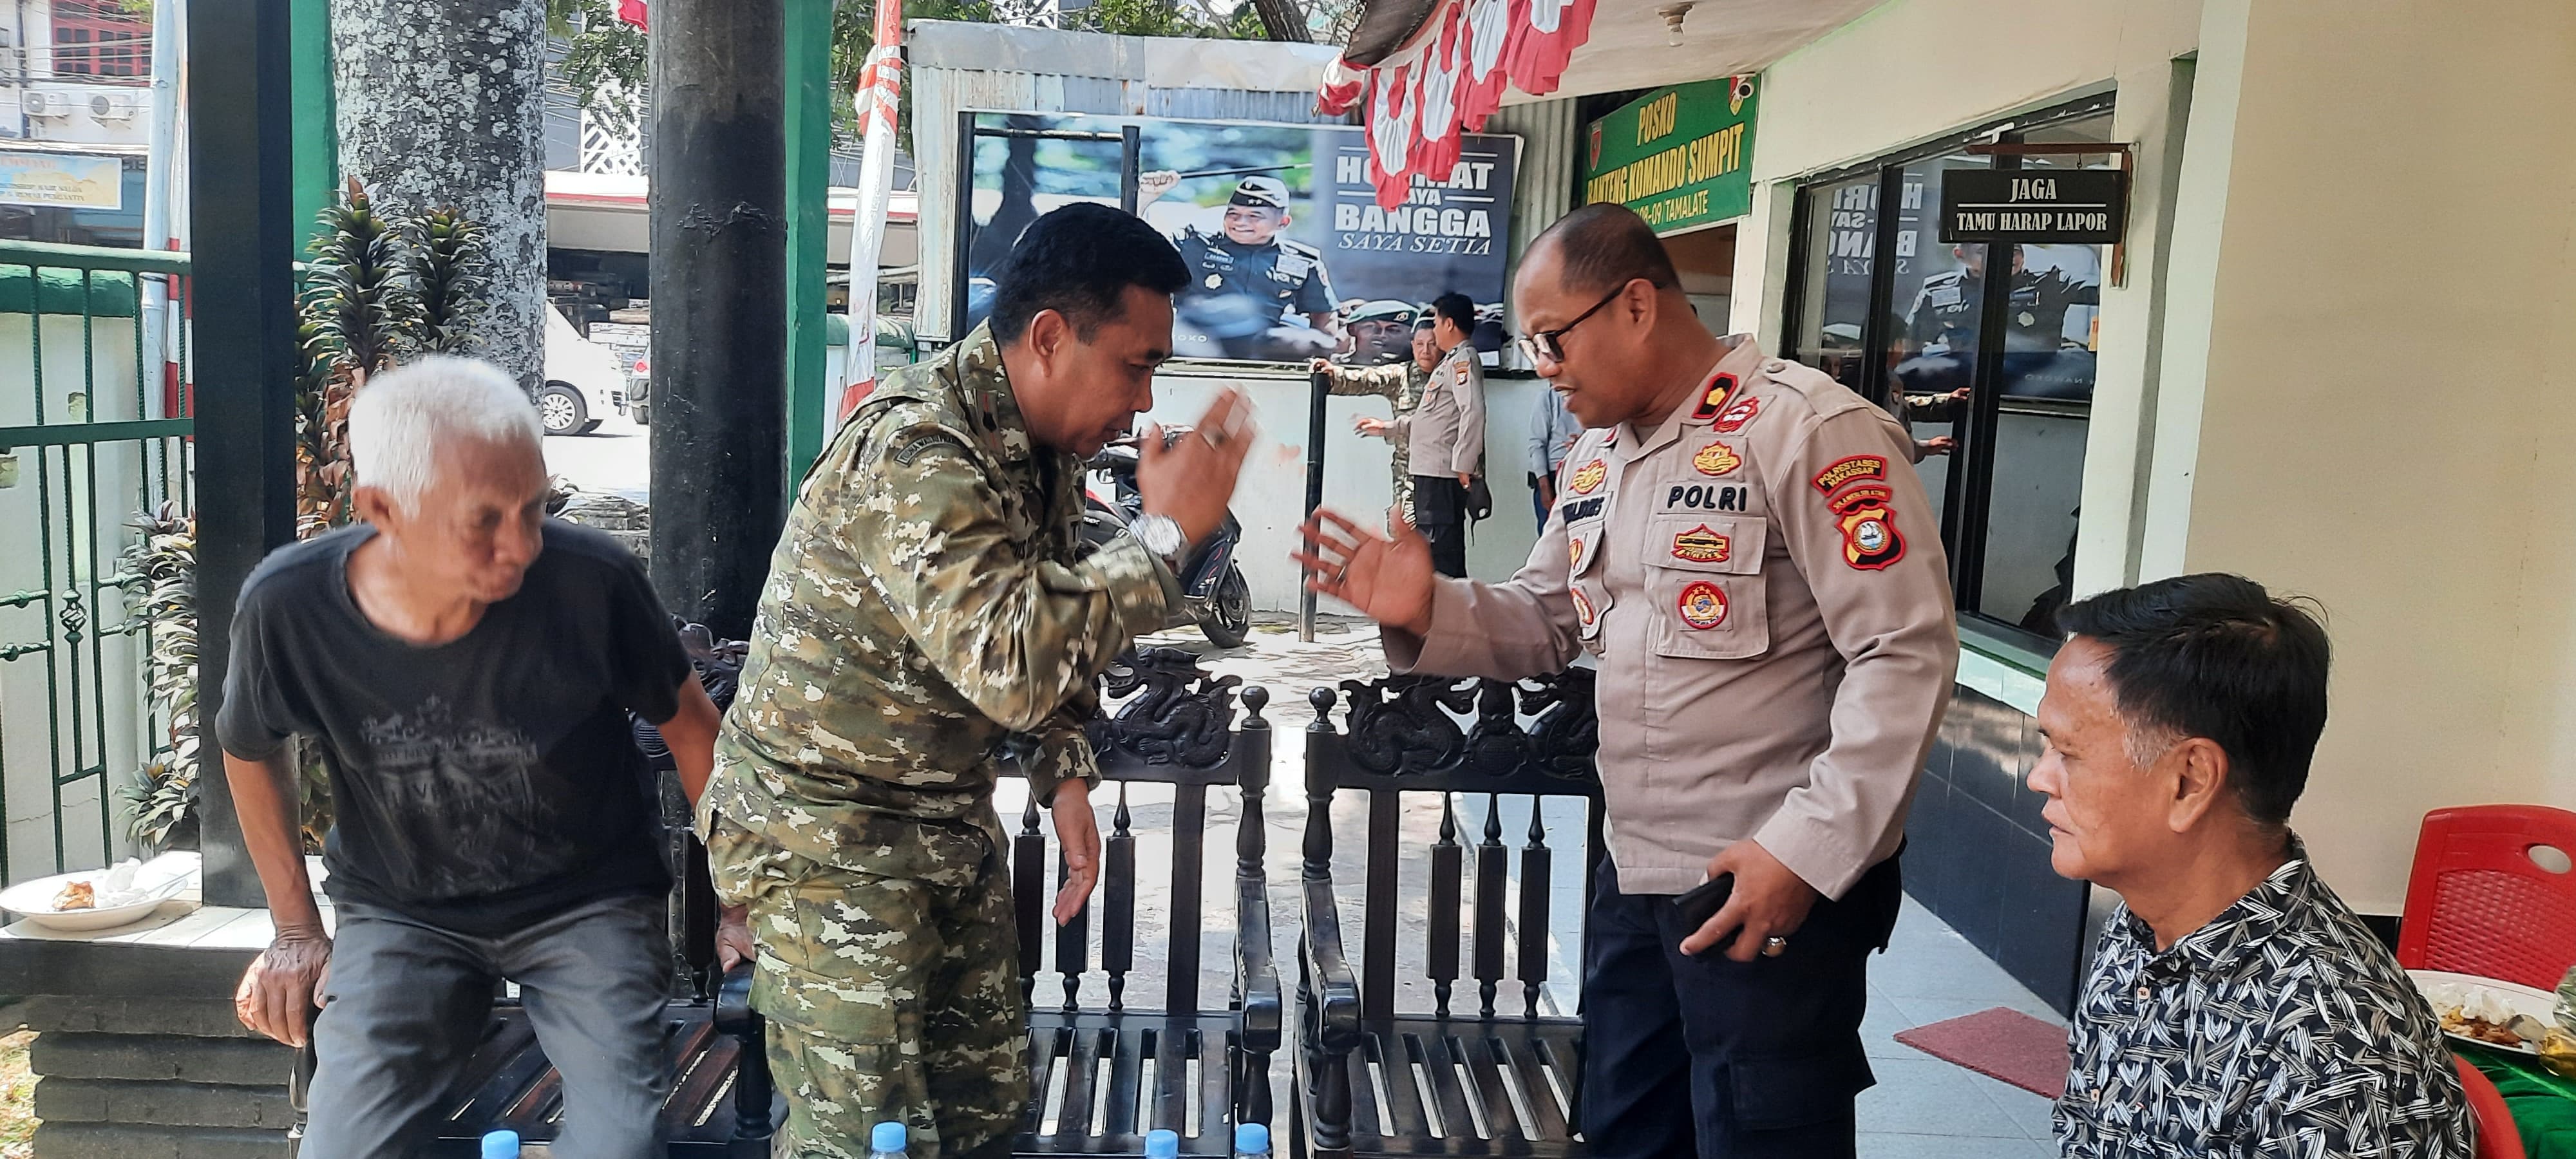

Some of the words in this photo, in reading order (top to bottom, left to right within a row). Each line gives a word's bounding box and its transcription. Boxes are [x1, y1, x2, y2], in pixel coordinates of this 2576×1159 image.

[1637, 92, 1677, 146] POSKO
[1628, 145, 1686, 202] KOMANDO
[1688, 123, 1745, 185] SUMPIT
[1408, 188, 1442, 205] AYA
[2009, 179, 2057, 202] JAGA
[1665, 189, 1709, 222] TAMALATE
[1335, 203, 1491, 237] BANGGA
[1956, 213, 1996, 231] TAMU
[2000, 213, 2052, 231] HARAP
[2056, 213, 2108, 231] LAPOR
[1338, 233, 1403, 251] SAYA
[1409, 236, 1492, 254] SETIA
[1828, 467, 1875, 487] MAKASSAR
[1667, 485, 1747, 512] POLRI
